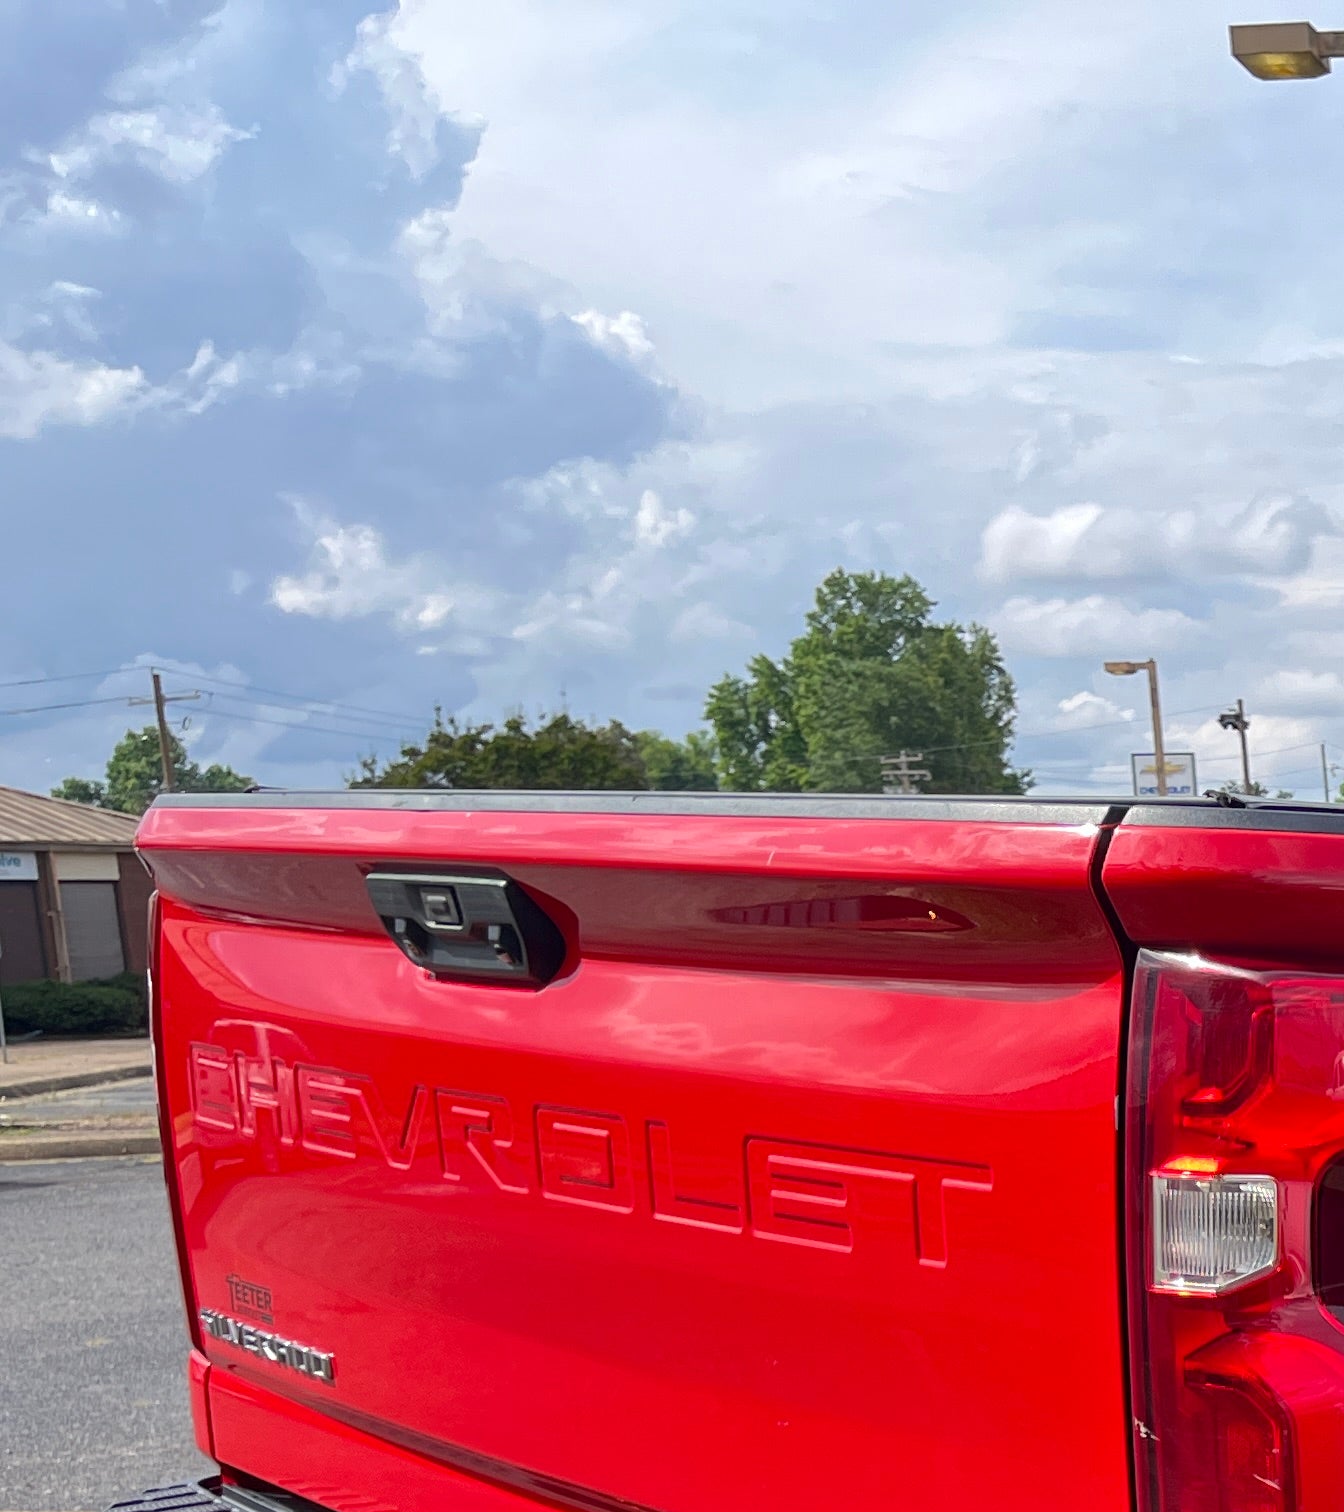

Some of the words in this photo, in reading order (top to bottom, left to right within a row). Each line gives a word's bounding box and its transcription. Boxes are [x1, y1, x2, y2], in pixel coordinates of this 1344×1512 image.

[189, 1042, 994, 1269] CHEVROLET
[226, 1273, 272, 1313] TEETER
[199, 1308, 335, 1381] SILVERADO
